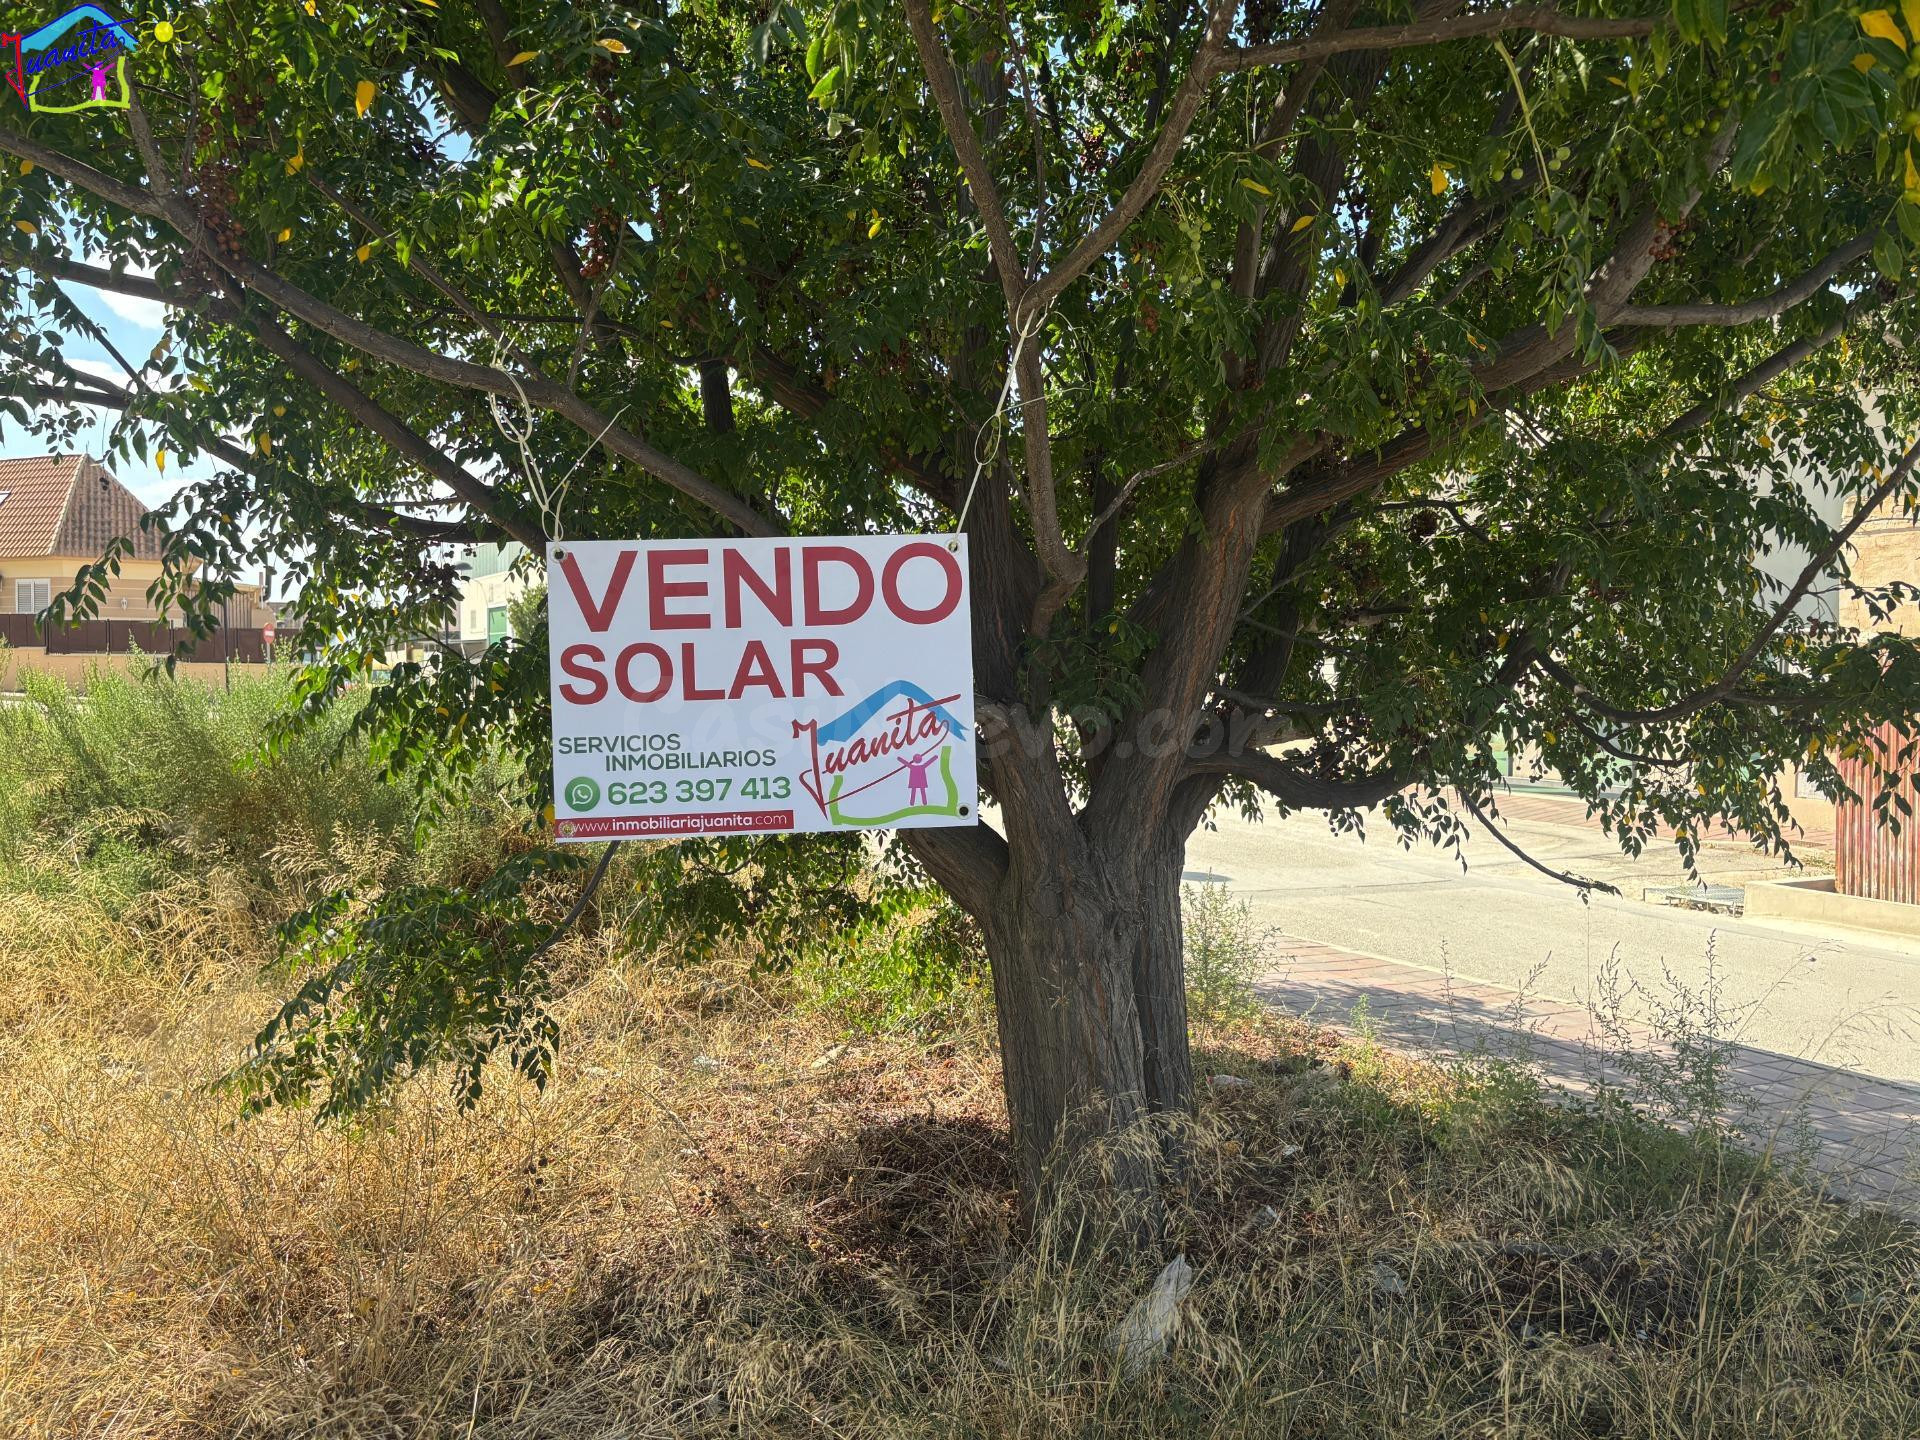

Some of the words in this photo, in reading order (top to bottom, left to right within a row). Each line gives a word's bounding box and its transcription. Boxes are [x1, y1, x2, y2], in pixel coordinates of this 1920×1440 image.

[560, 542, 963, 633] VENDO
[558, 638, 845, 706] SOLAR
[558, 733, 681, 755] SERVICIOS
[792, 693, 962, 821] Juanita
[605, 749, 777, 772] INMOBILIARIOS
[607, 780, 668, 805] 623
[675, 778, 733, 803] 397
[740, 776, 792, 800] 413
[573, 812, 787, 832] www.inmobiliariajuanita.com
